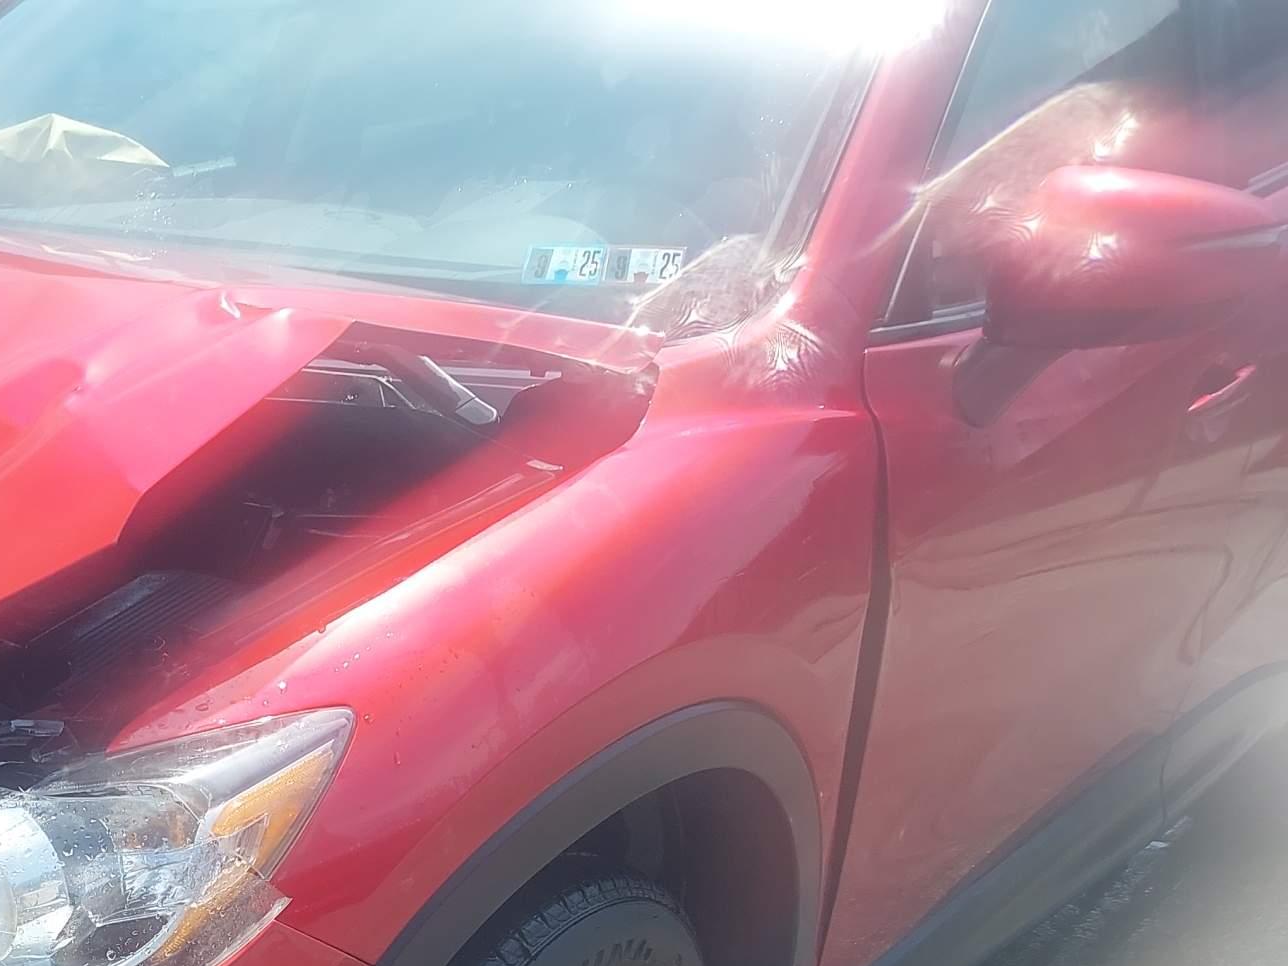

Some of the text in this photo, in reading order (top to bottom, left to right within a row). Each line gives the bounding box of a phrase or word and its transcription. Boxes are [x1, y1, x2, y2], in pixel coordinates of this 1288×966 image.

[579, 250, 601, 277] 25
[615, 255, 628, 279] 9
[659, 252, 681, 279] 25
